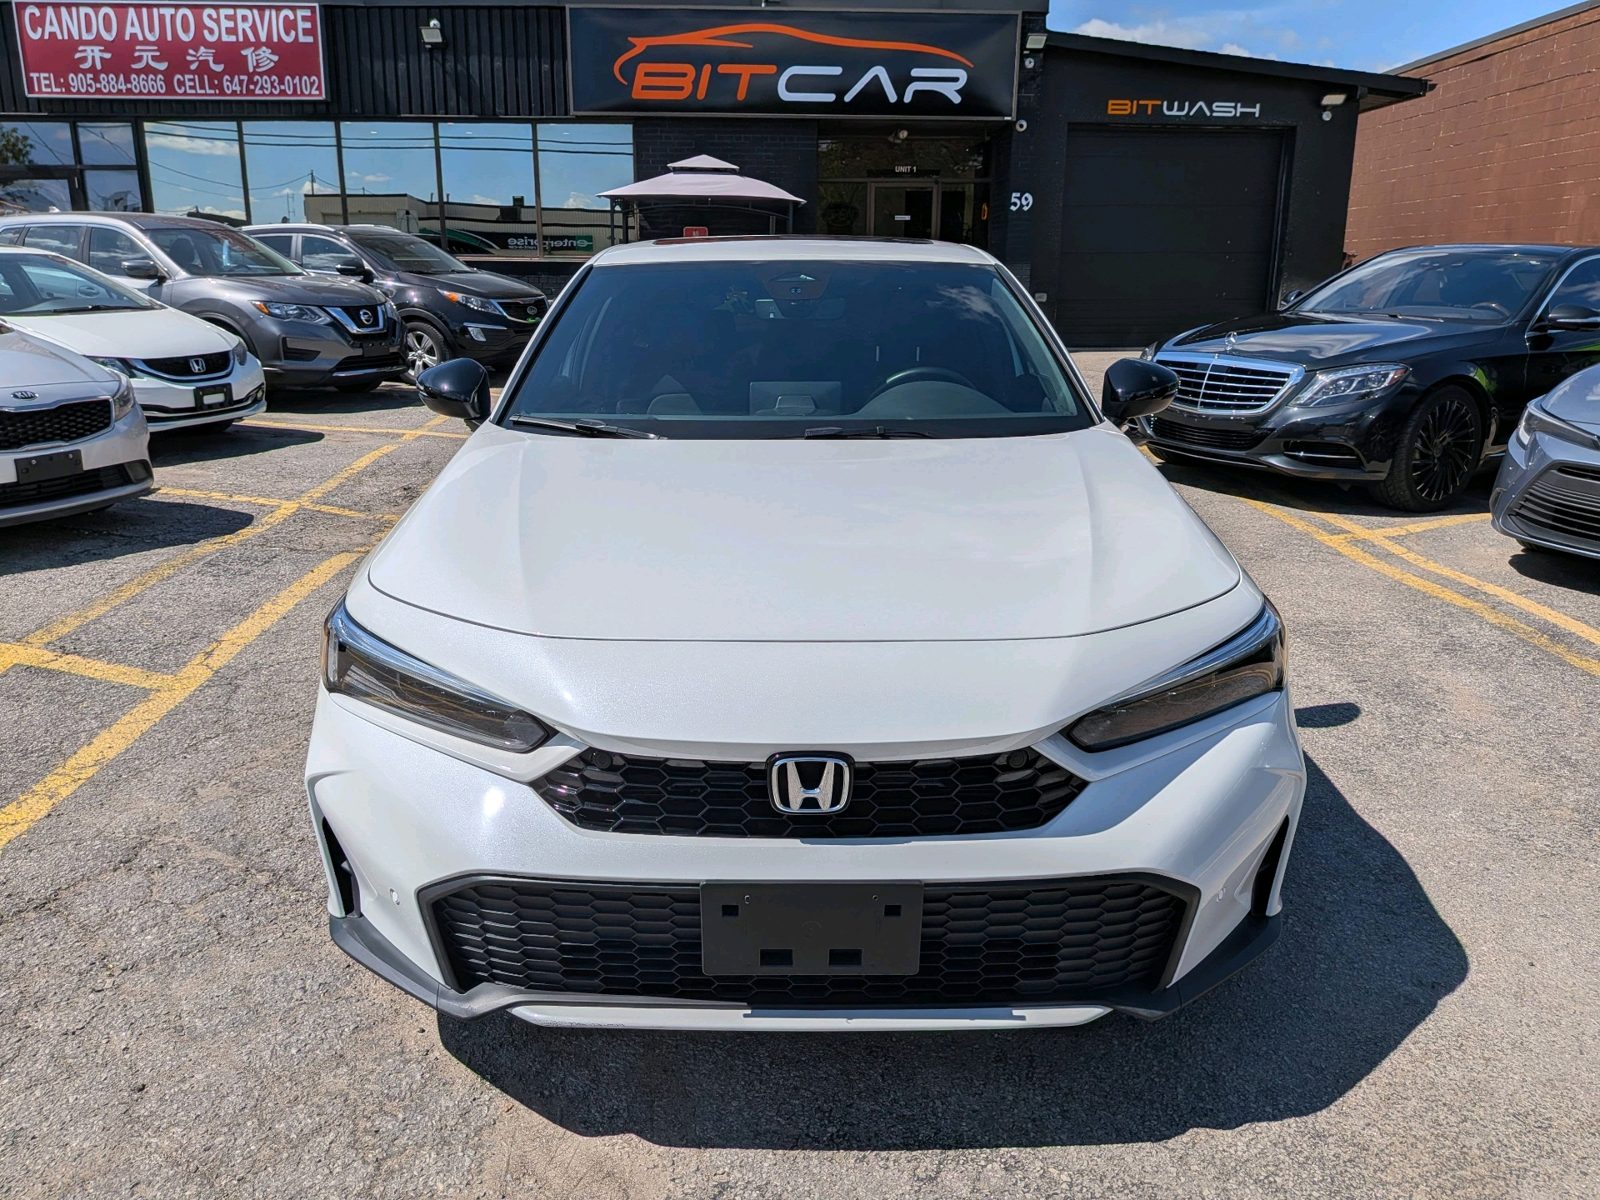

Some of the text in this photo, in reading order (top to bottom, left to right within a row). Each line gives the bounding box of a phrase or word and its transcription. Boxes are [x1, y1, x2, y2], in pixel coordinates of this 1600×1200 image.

[24, 6, 314, 43] CANDO AUTO SERVICE
[74, 45, 279, 73] 开元汽修
[30, 73, 319, 95] TEL: 905-884-8666 CELL: 647-293-0102
[631, 63, 968, 103] BITCAR
[895, 165, 917, 173] UNIT 1
[1010, 192, 1033, 211] 59
